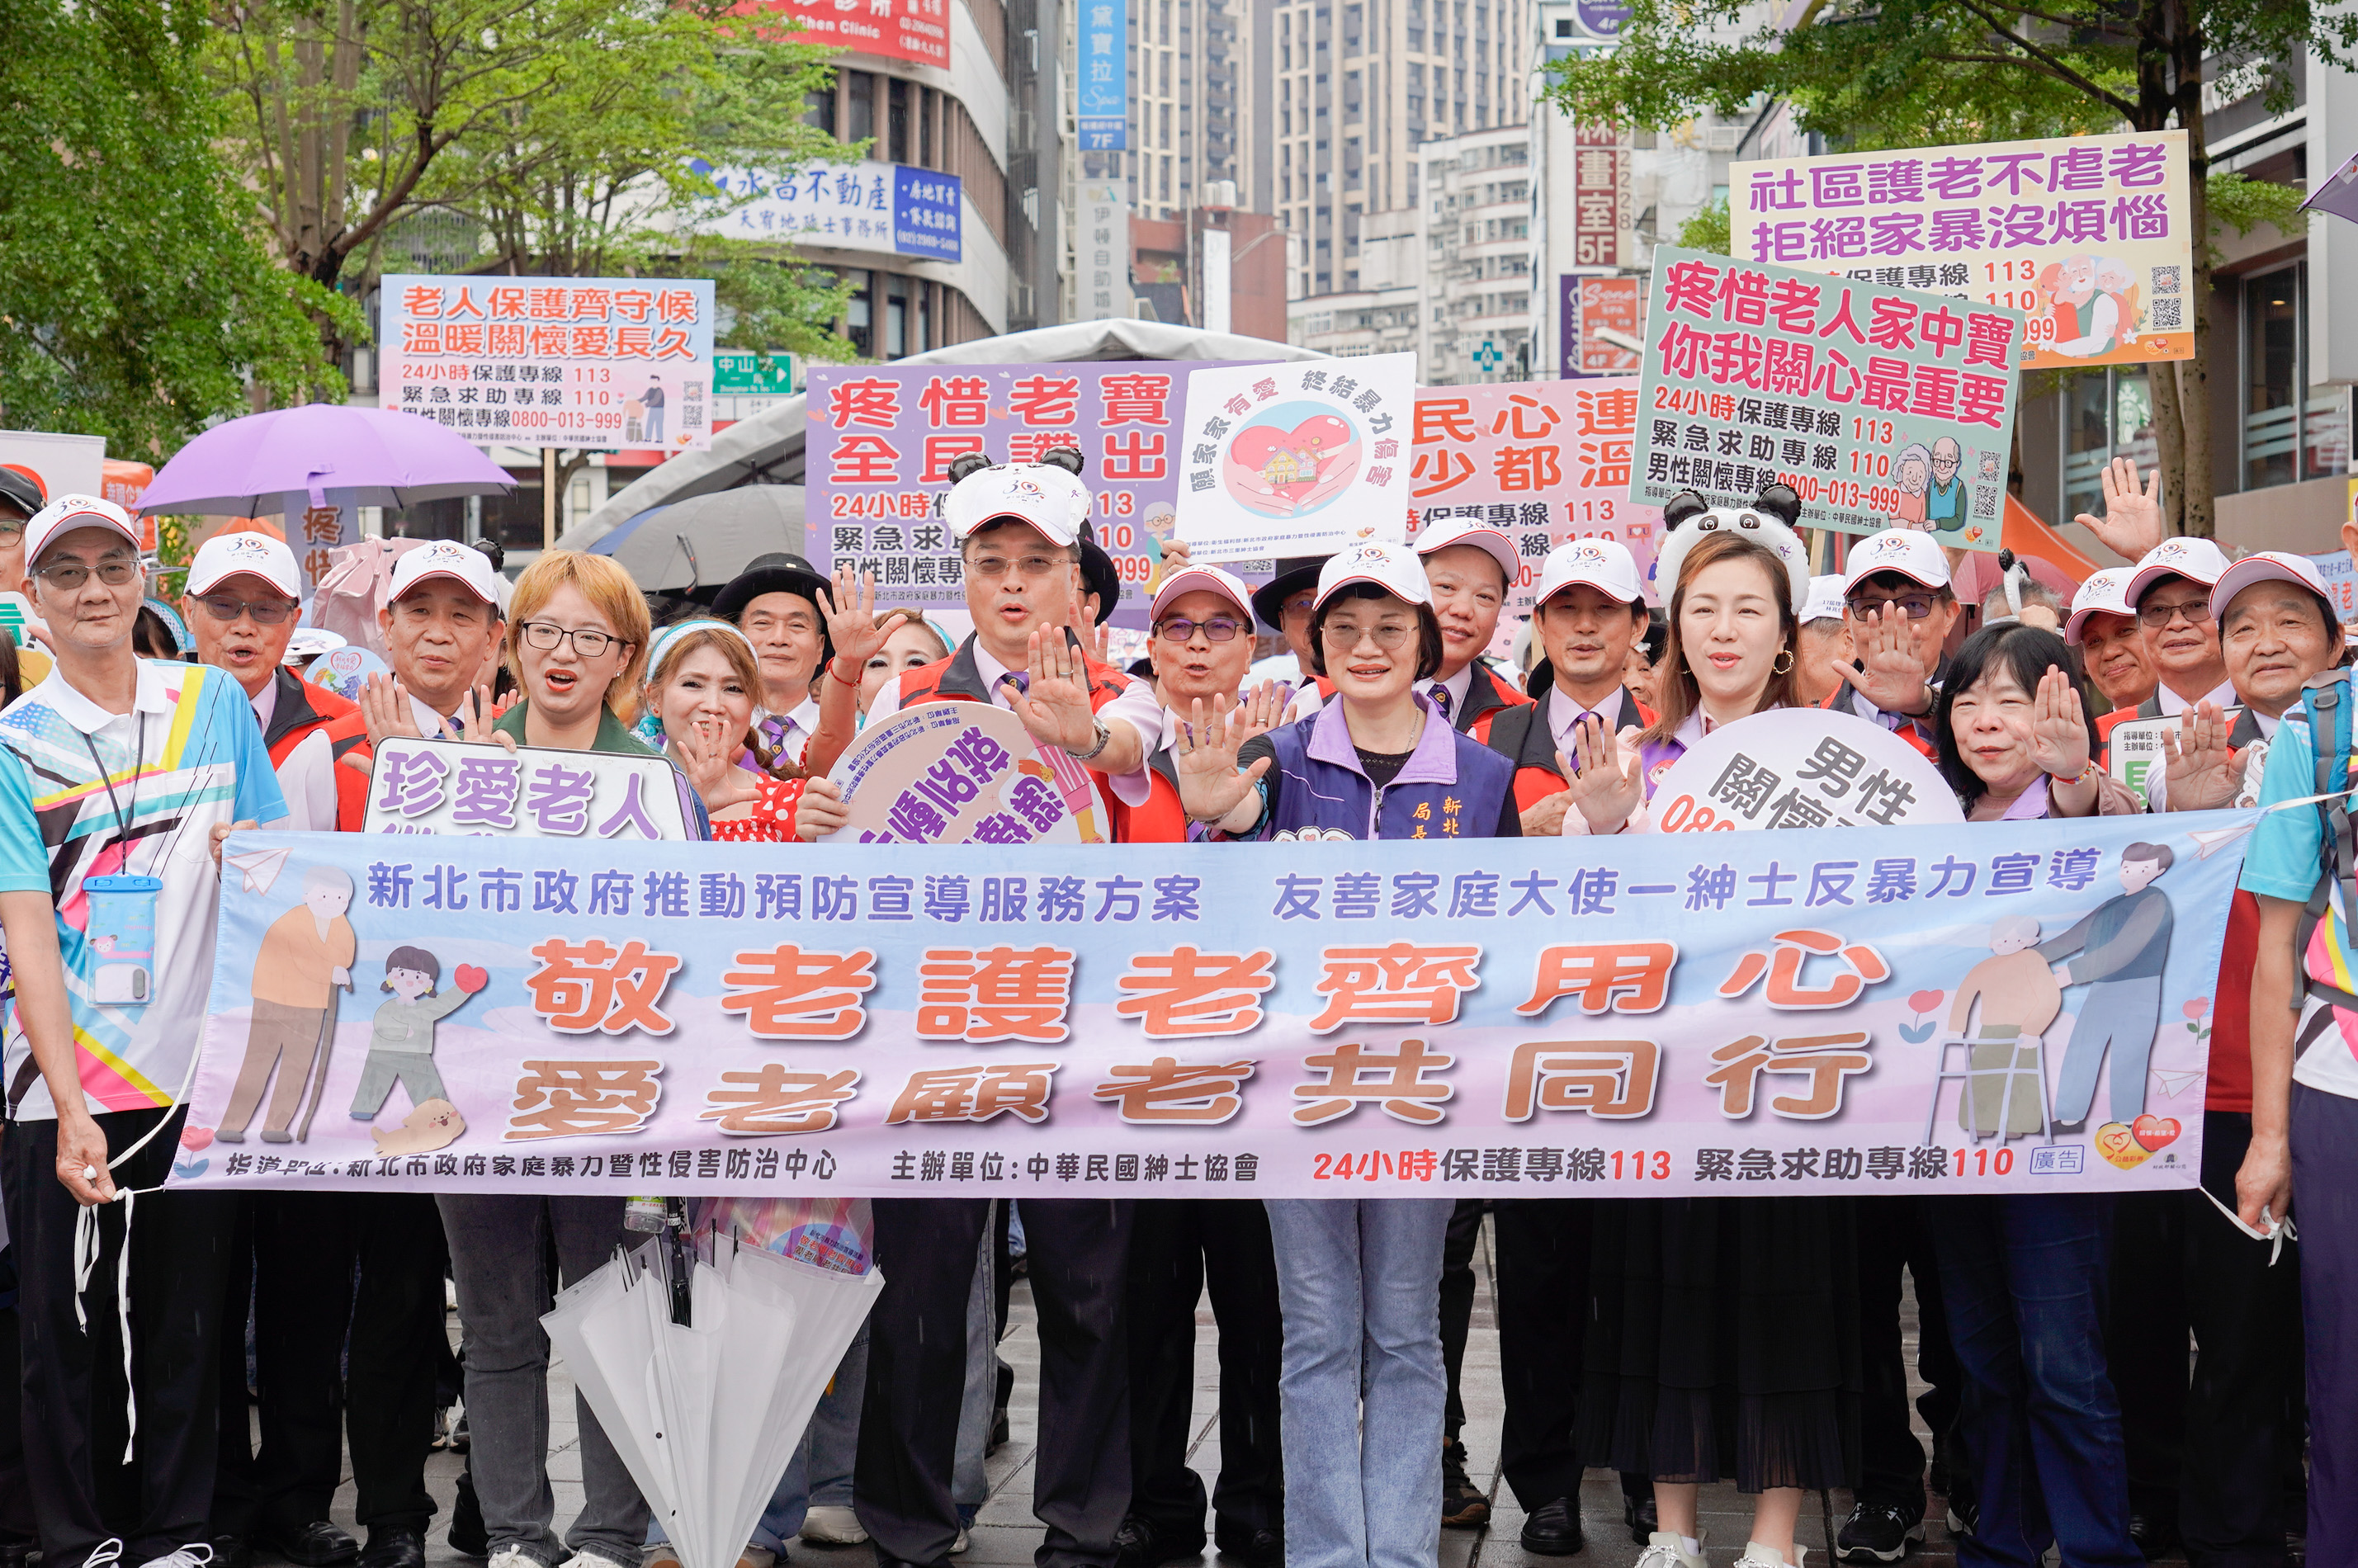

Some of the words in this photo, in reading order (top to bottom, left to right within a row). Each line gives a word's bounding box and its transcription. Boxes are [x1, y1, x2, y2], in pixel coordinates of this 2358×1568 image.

[839, 19, 881, 40] Clinic
[1090, 133, 1114, 149] 7F
[1749, 143, 2168, 213] 社區護老不虐老
[1577, 234, 1615, 264] 5F
[1751, 194, 2170, 264] 拒絕家暴沒煩惱
[1984, 259, 2036, 282] 113
[403, 285, 698, 324] 老人保護齊守候
[1664, 259, 2016, 371] 疼惜老人家中寶
[402, 323, 696, 360] 溫暖關懷愛長久
[402, 363, 564, 383] 24小時保護專線
[574, 367, 611, 383] 113
[402, 385, 564, 406] 緊急求助專線
[574, 390, 610, 406] 110
[828, 373, 1173, 429] 疼惜老寶
[1657, 319, 2011, 430] 你我關心最重要
[1300, 370, 1401, 488] 終結暴力傷害
[1654, 385, 1842, 438] 24小時保護專線
[1852, 417, 1895, 444] 113
[1650, 418, 1840, 471] 緊急求助專線
[1850, 450, 1890, 478] 110
[1563, 499, 1615, 522] 113
[379, 749, 661, 841] 珍愛老人
[1795, 734, 1917, 827] 男性
[1442, 795, 1463, 839] 新北
[366, 861, 1202, 923] 新北市政府推動預防宣導服務方案
[526, 928, 1890, 1041] 敬老護老齊用心
[503, 1032, 1873, 1142] 愛老顧老共同行
[2033, 1149, 2082, 1173] 廣告
